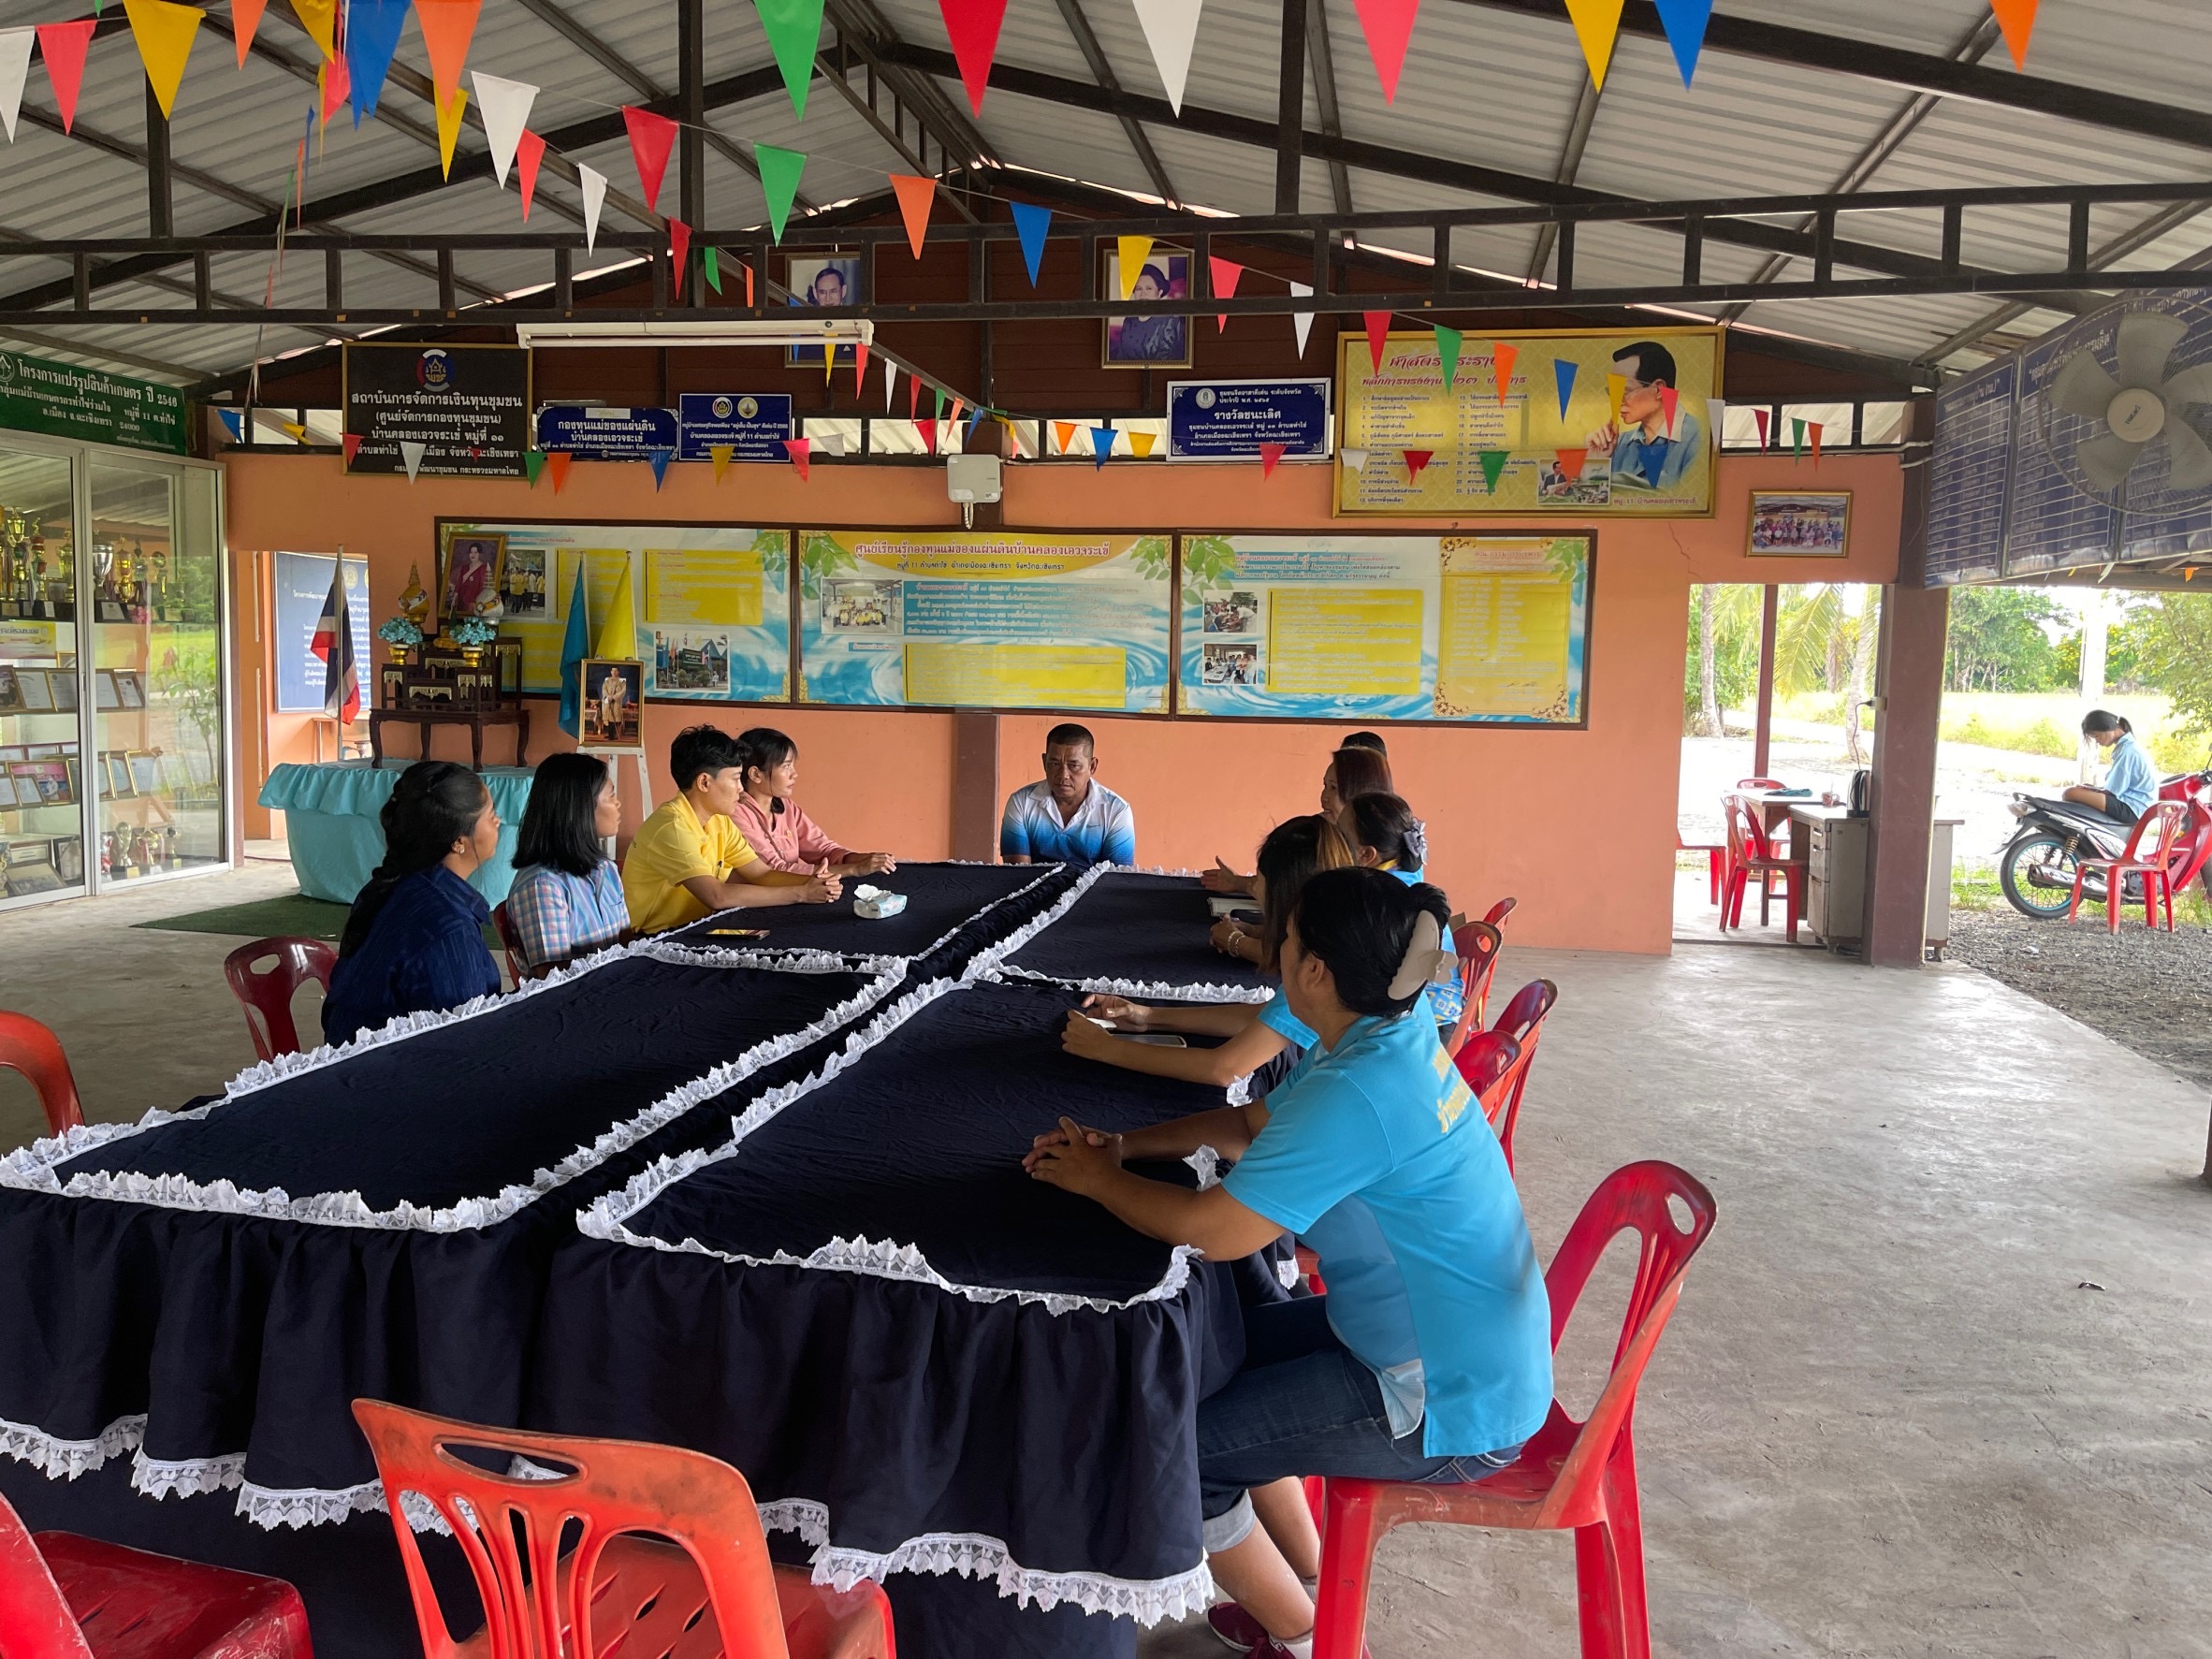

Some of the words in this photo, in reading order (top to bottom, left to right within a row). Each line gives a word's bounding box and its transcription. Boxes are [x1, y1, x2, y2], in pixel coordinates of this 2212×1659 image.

[17, 358, 141, 400] โครงการแปรรูปสินค้าเกษตร
[145, 386, 154, 403] ปี
[351, 389, 523, 412] สถาบันการจัดการเงินทุนชุมชน
[375, 408, 502, 429] (ศูนย์จัดการกองทุนชุมชน)
[1214, 407, 1282, 420] รางวัลชนะเลิศ
[371, 426, 460, 441] บ้านคลองเอวจระเข้
[464, 428, 488, 445] หมู่ที่
[558, 418, 656, 434] กองทุนแม่ของแผ่นดิน
[570, 430, 644, 443] บ้านคลองเอวจระเข้
[459, 465, 519, 475] กระทรวงมหาดไทย
[854, 538, 1111, 559] ศูนย์เรียนรู้กองทุนแม่ของแผ่นดินบ้านคลองเอวจระเข้
